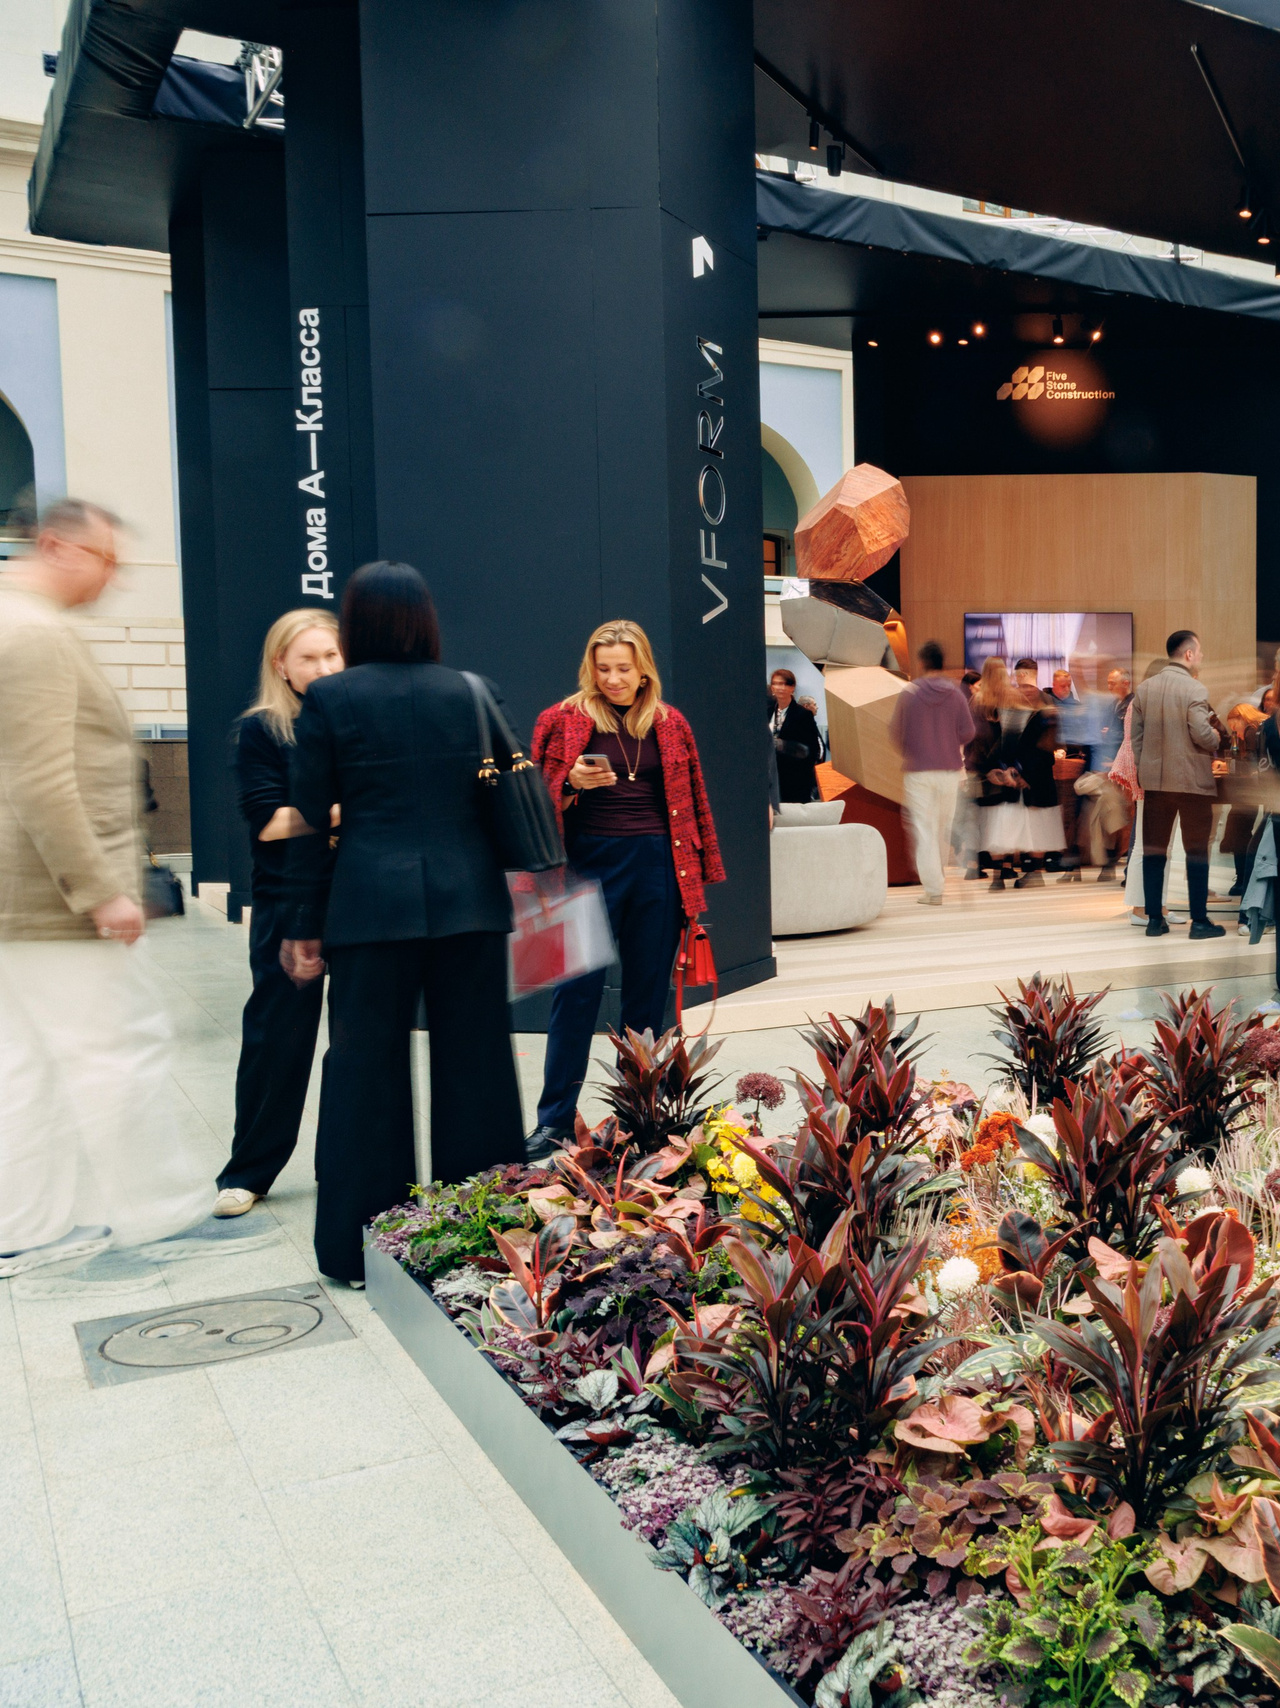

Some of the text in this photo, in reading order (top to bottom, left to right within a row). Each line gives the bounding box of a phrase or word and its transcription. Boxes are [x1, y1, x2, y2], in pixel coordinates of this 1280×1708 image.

[1046, 371, 1067, 381] Five
[1046, 380, 1077, 390] Stone
[1046, 389, 1115, 399] Construction
[696, 334, 728, 624] VFORM
[301, 507, 334, 599] Дома
